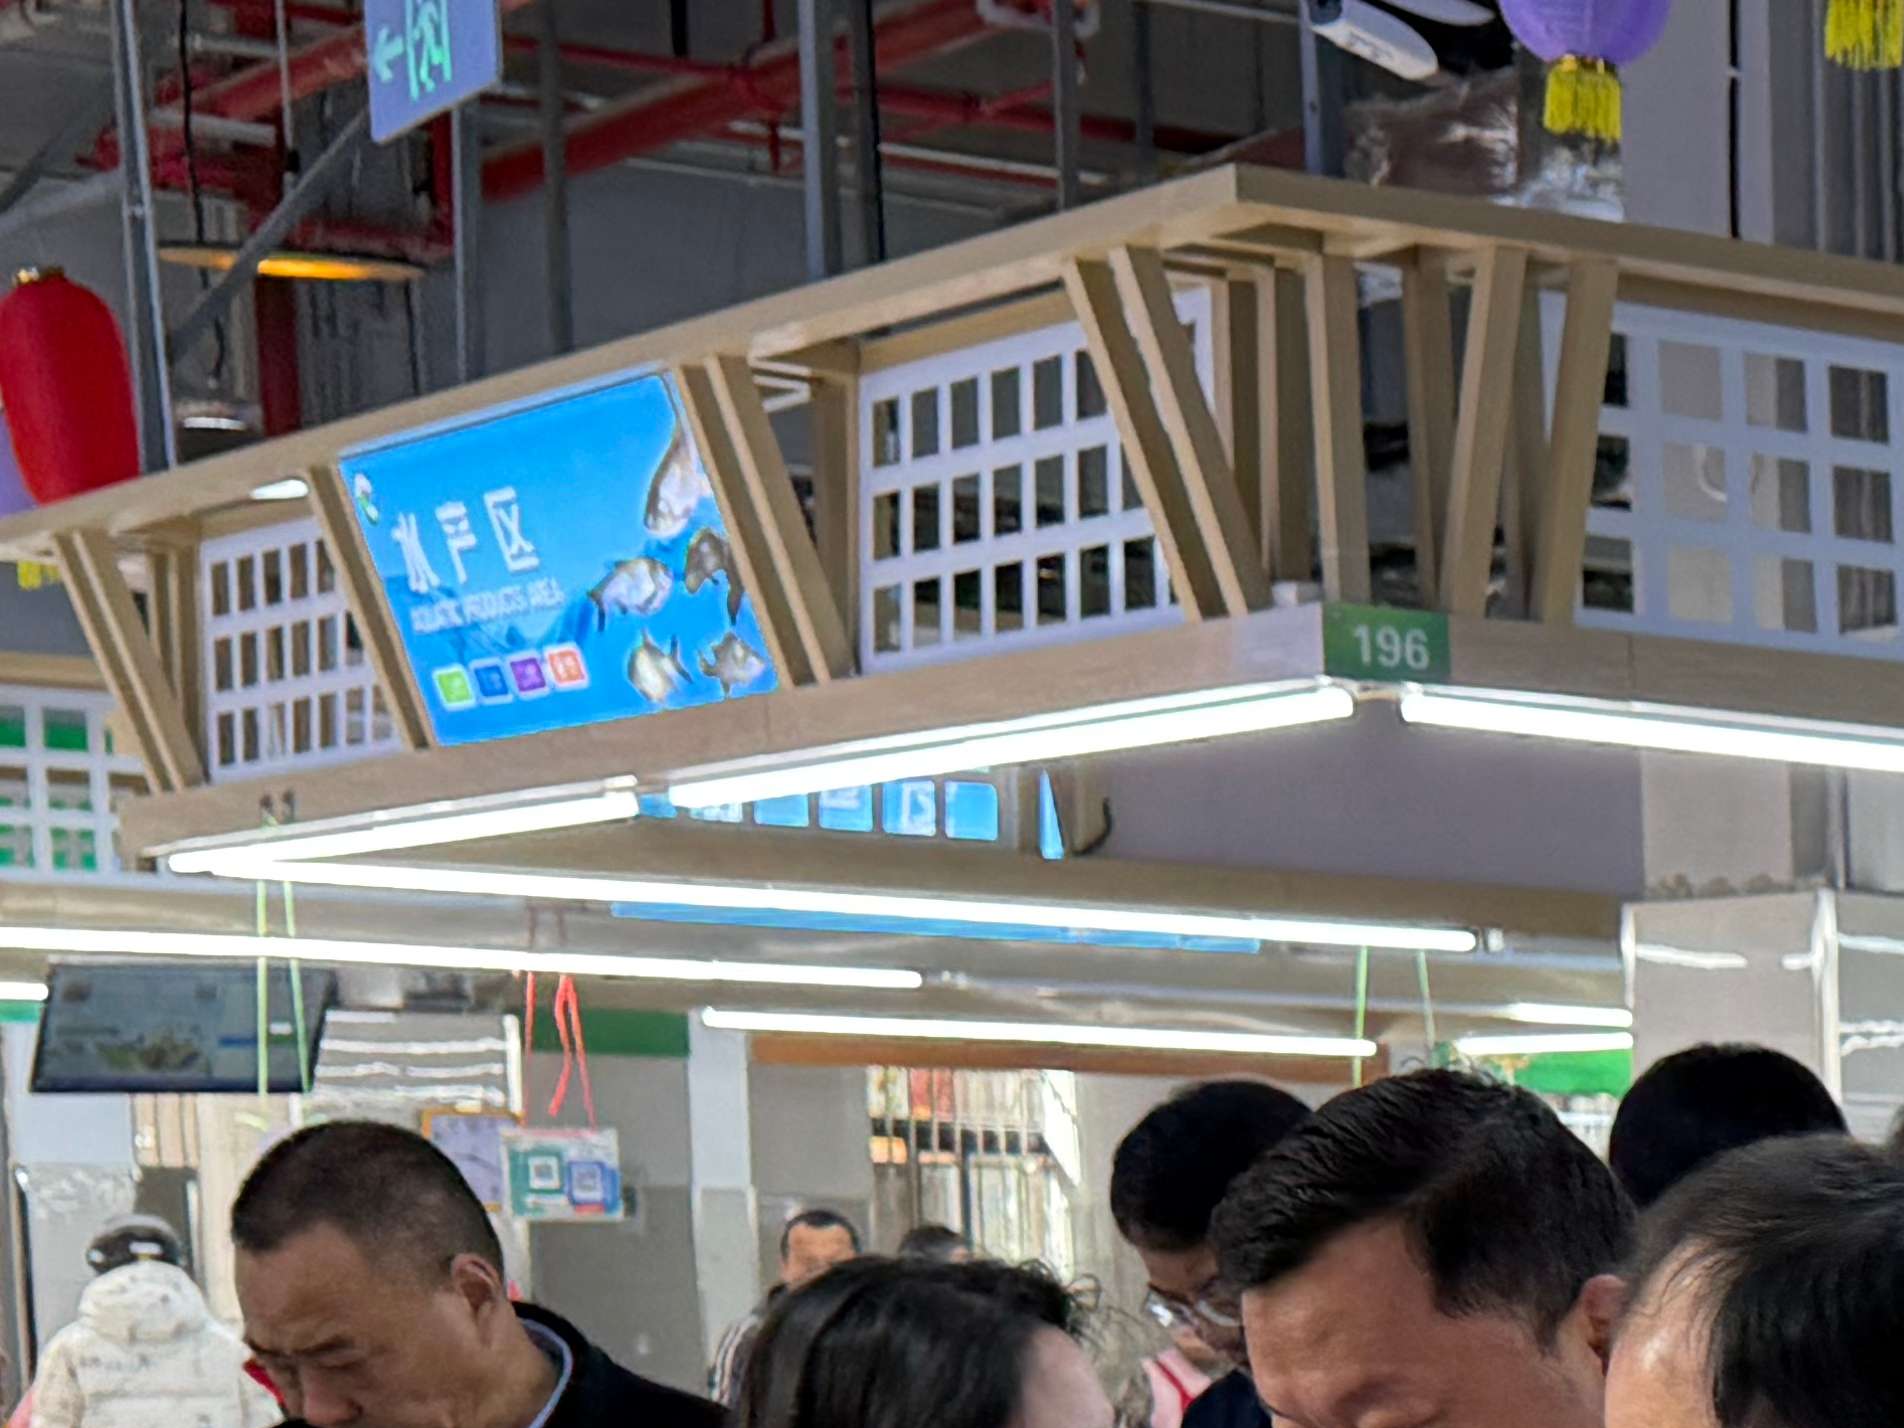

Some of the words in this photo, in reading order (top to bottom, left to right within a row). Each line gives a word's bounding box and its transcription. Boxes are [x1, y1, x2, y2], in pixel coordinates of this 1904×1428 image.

[391, 485, 541, 594] 水产区
[1353, 623, 1430, 671] 196
